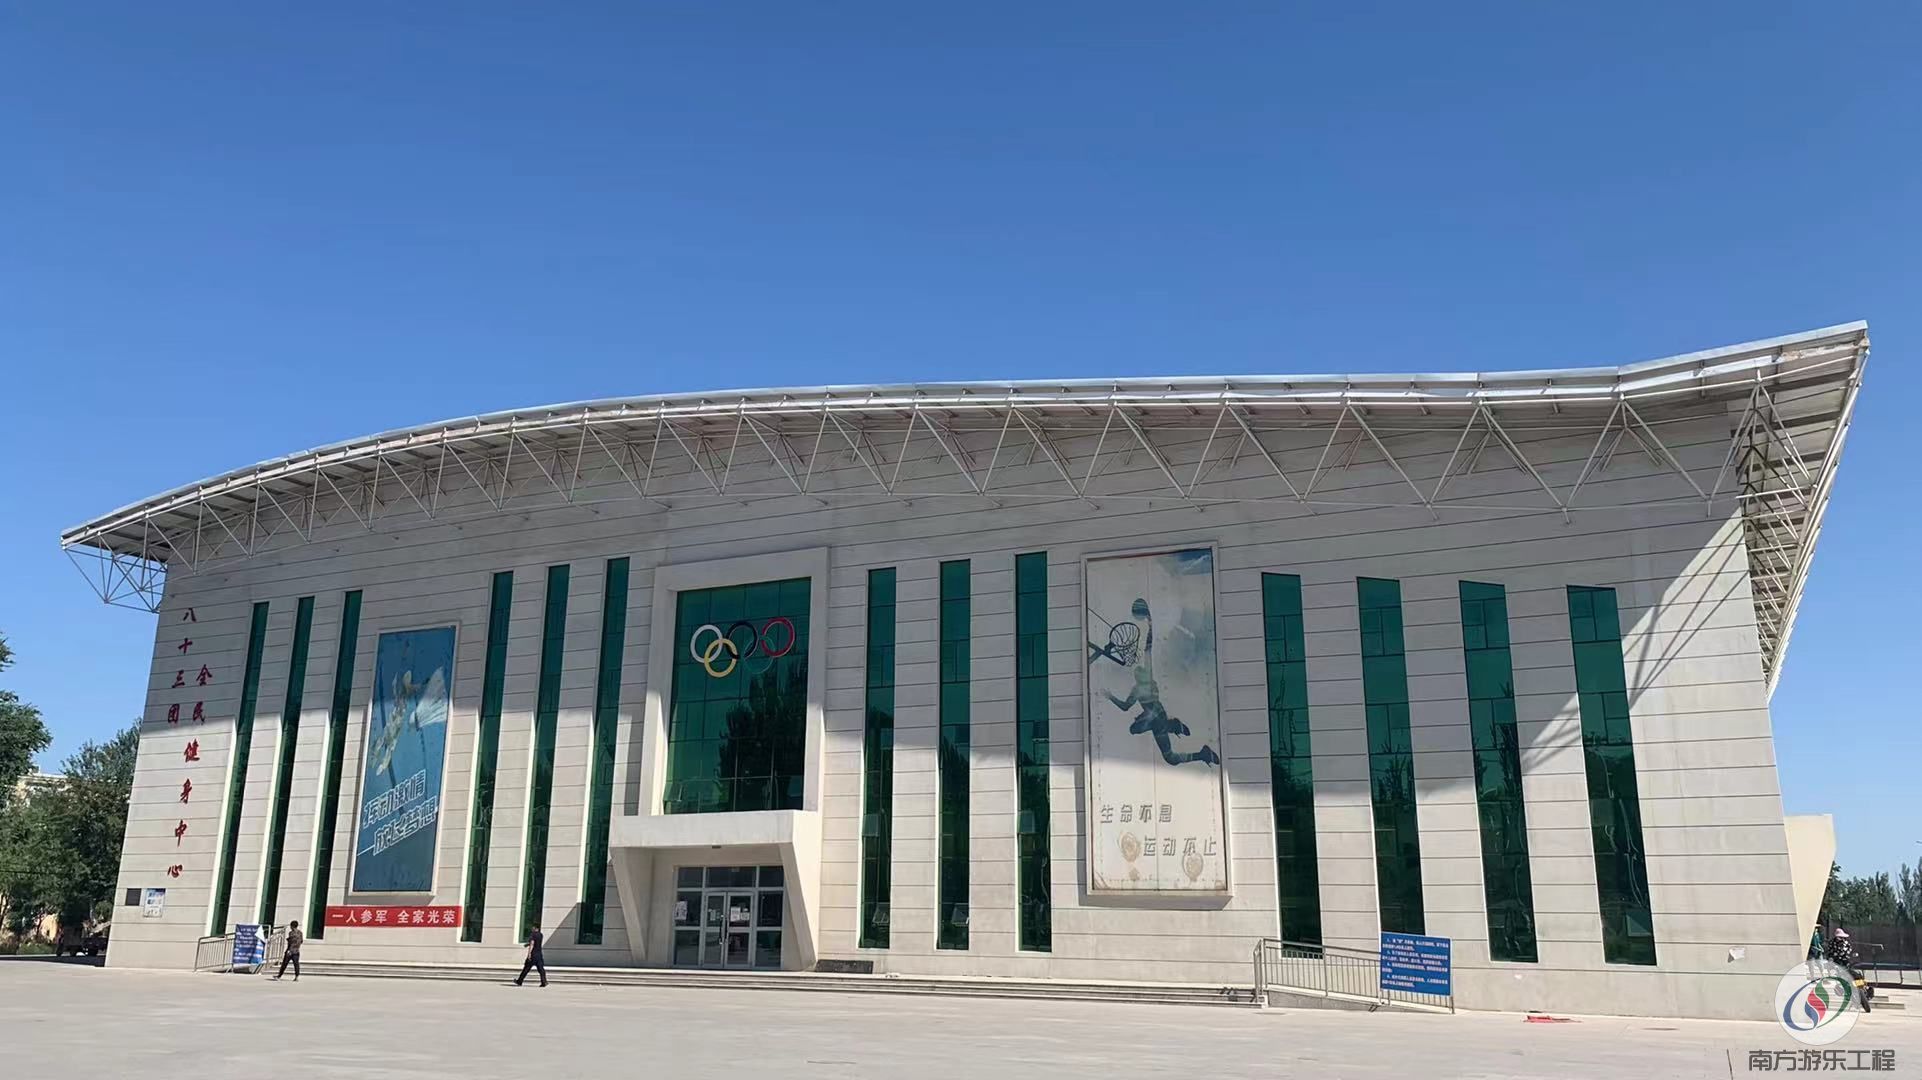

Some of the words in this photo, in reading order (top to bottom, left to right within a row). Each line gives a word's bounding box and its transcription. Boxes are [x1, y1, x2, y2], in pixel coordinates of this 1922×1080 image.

[168, 607, 197, 724] 八十三团
[167, 664, 212, 878] 全民健身中心
[1100, 804, 1172, 823] 生命不息
[1143, 835, 1217, 857] 运动不止
[332, 910, 388, 923] 一人参军
[397, 910, 456, 924] 全家光荣
